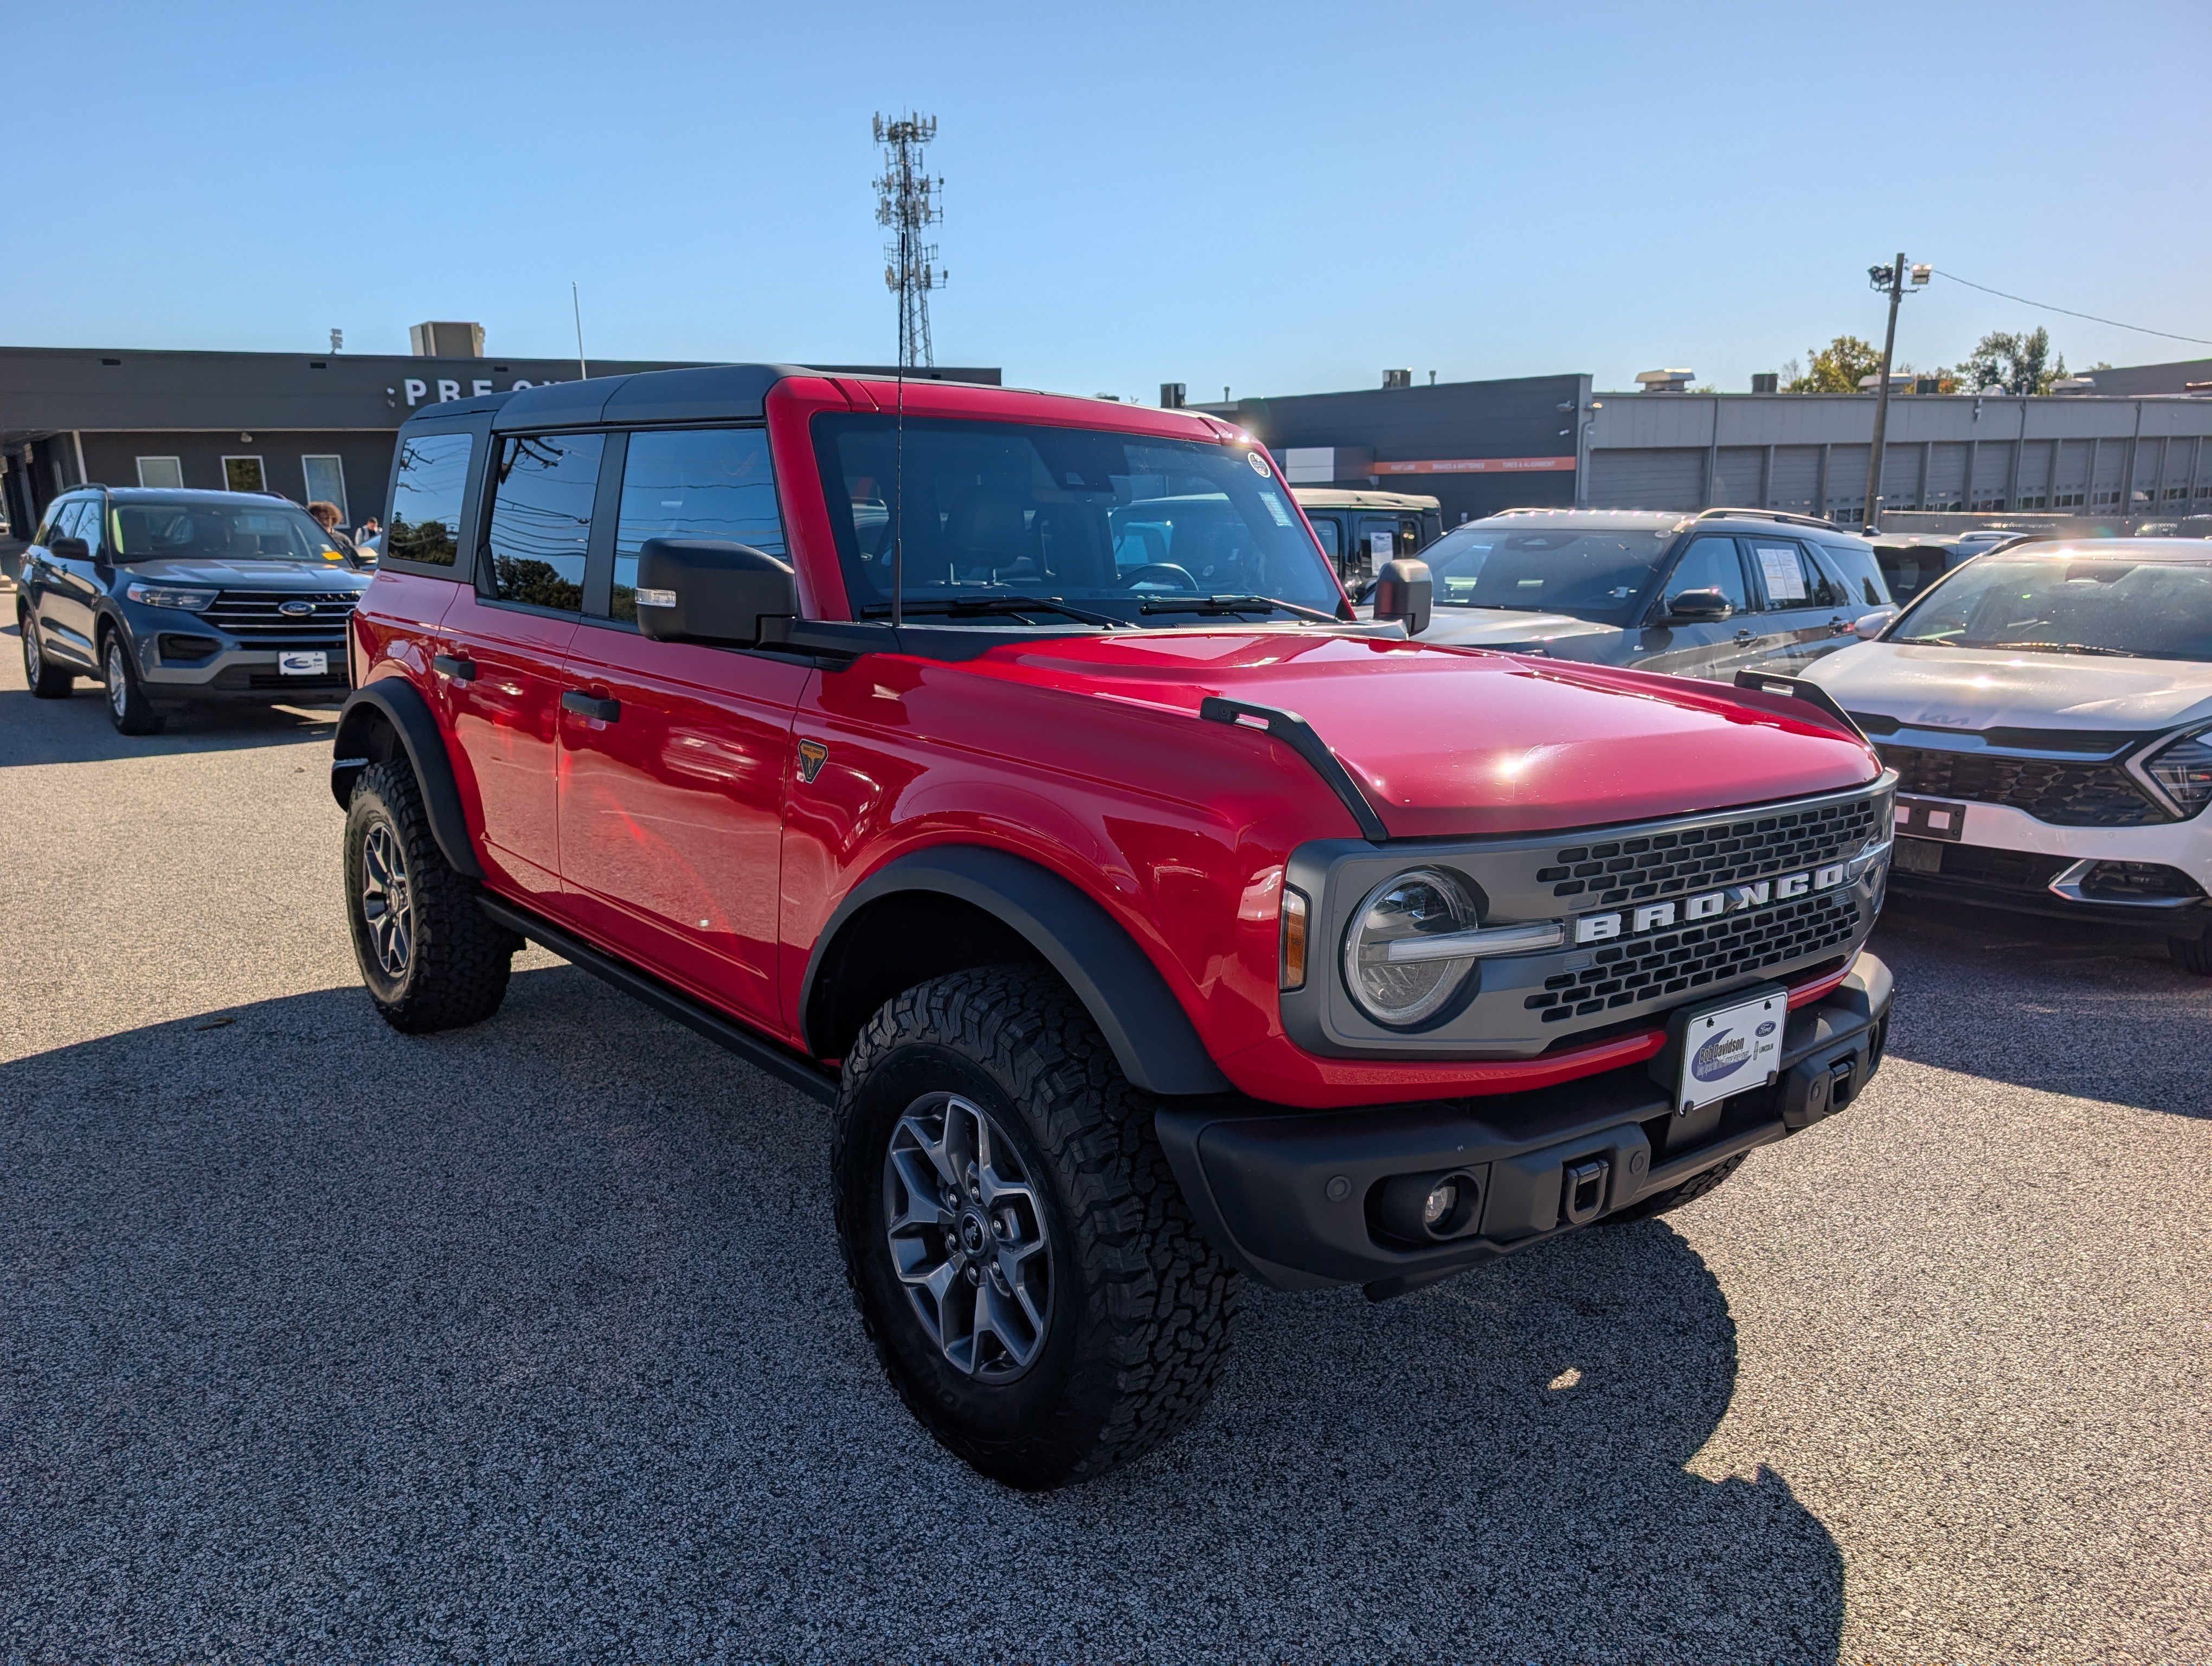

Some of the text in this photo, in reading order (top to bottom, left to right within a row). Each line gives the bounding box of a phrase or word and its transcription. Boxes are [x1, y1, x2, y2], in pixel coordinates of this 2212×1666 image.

[404, 379, 492, 406] PRE
[1575, 863, 1844, 943] BRONCO
[1699, 1045, 1714, 1063] Bob
[1714, 1037, 1745, 1059] Davidson
